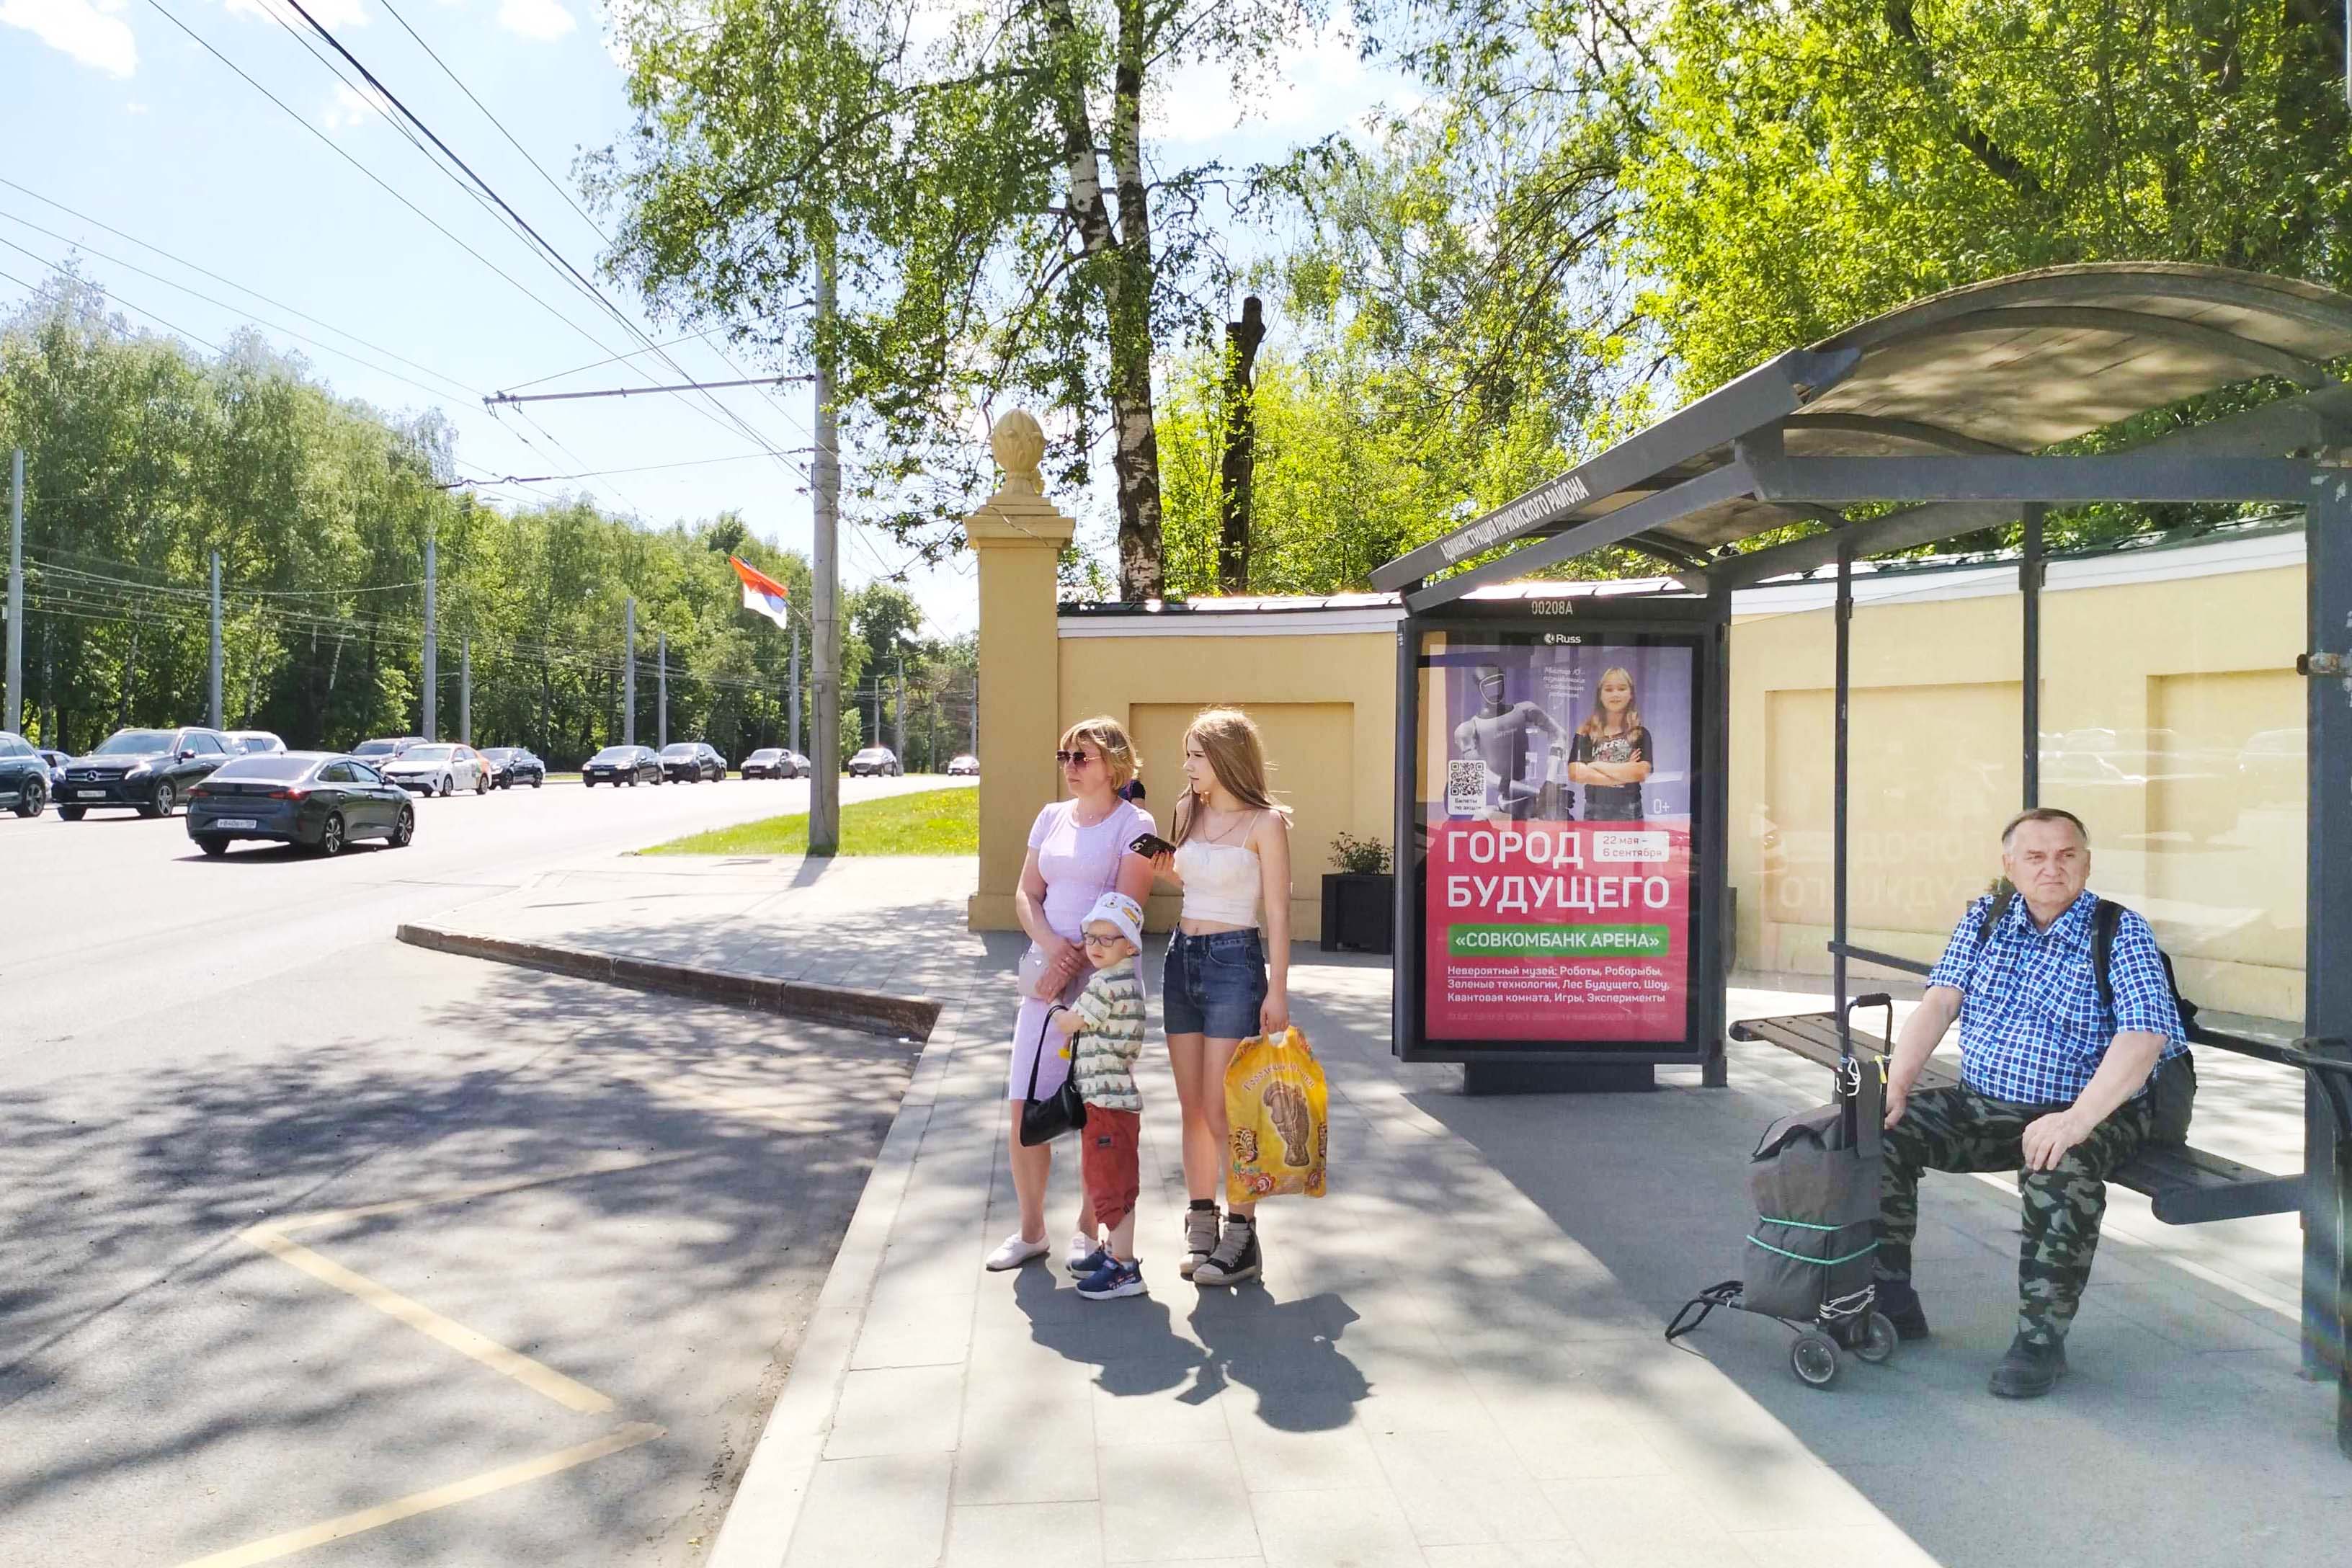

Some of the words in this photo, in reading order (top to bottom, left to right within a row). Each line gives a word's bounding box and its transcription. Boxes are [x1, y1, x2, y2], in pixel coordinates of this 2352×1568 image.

[1440, 517, 1498, 563] АДМИНИСТРАЦИЯ
[1494, 494, 1550, 536] ПРИОКСКОГО
[1544, 476, 1590, 512] РАЙОНА
[1556, 634, 1582, 643] Russ
[1653, 798, 1670, 814] 0+
[1603, 836, 1617, 845] 22
[1448, 831, 1584, 870] ГОРОД
[1603, 847, 1610, 857] 6
[1613, 848, 1662, 859] сентября
[1448, 876, 1669, 914] БУДУЩЕГО
[1456, 932, 1587, 948] «СОВКОМБАНК
[1590, 932, 1660, 948] АРЕНА»
[1448, 966, 1519, 977] Невероятный
[1522, 966, 1558, 978] музей:
[1559, 966, 1603, 976] Роботы,
[1605, 966, 1662, 978] Роборыбы,
[1448, 979, 1494, 989] Зеленые
[1497, 980, 1561, 989] технологии,
[1562, 979, 1582, 989] Лес
[1585, 979, 1642, 991] Будущего,
[1644, 979, 1670, 992] Шоу,
[1448, 992, 1504, 1002] Квантовая
[1505, 994, 1552, 1004] комната,
[1554, 993, 1585, 1004] Игры,
[1587, 993, 1666, 1004] Эксперименты
